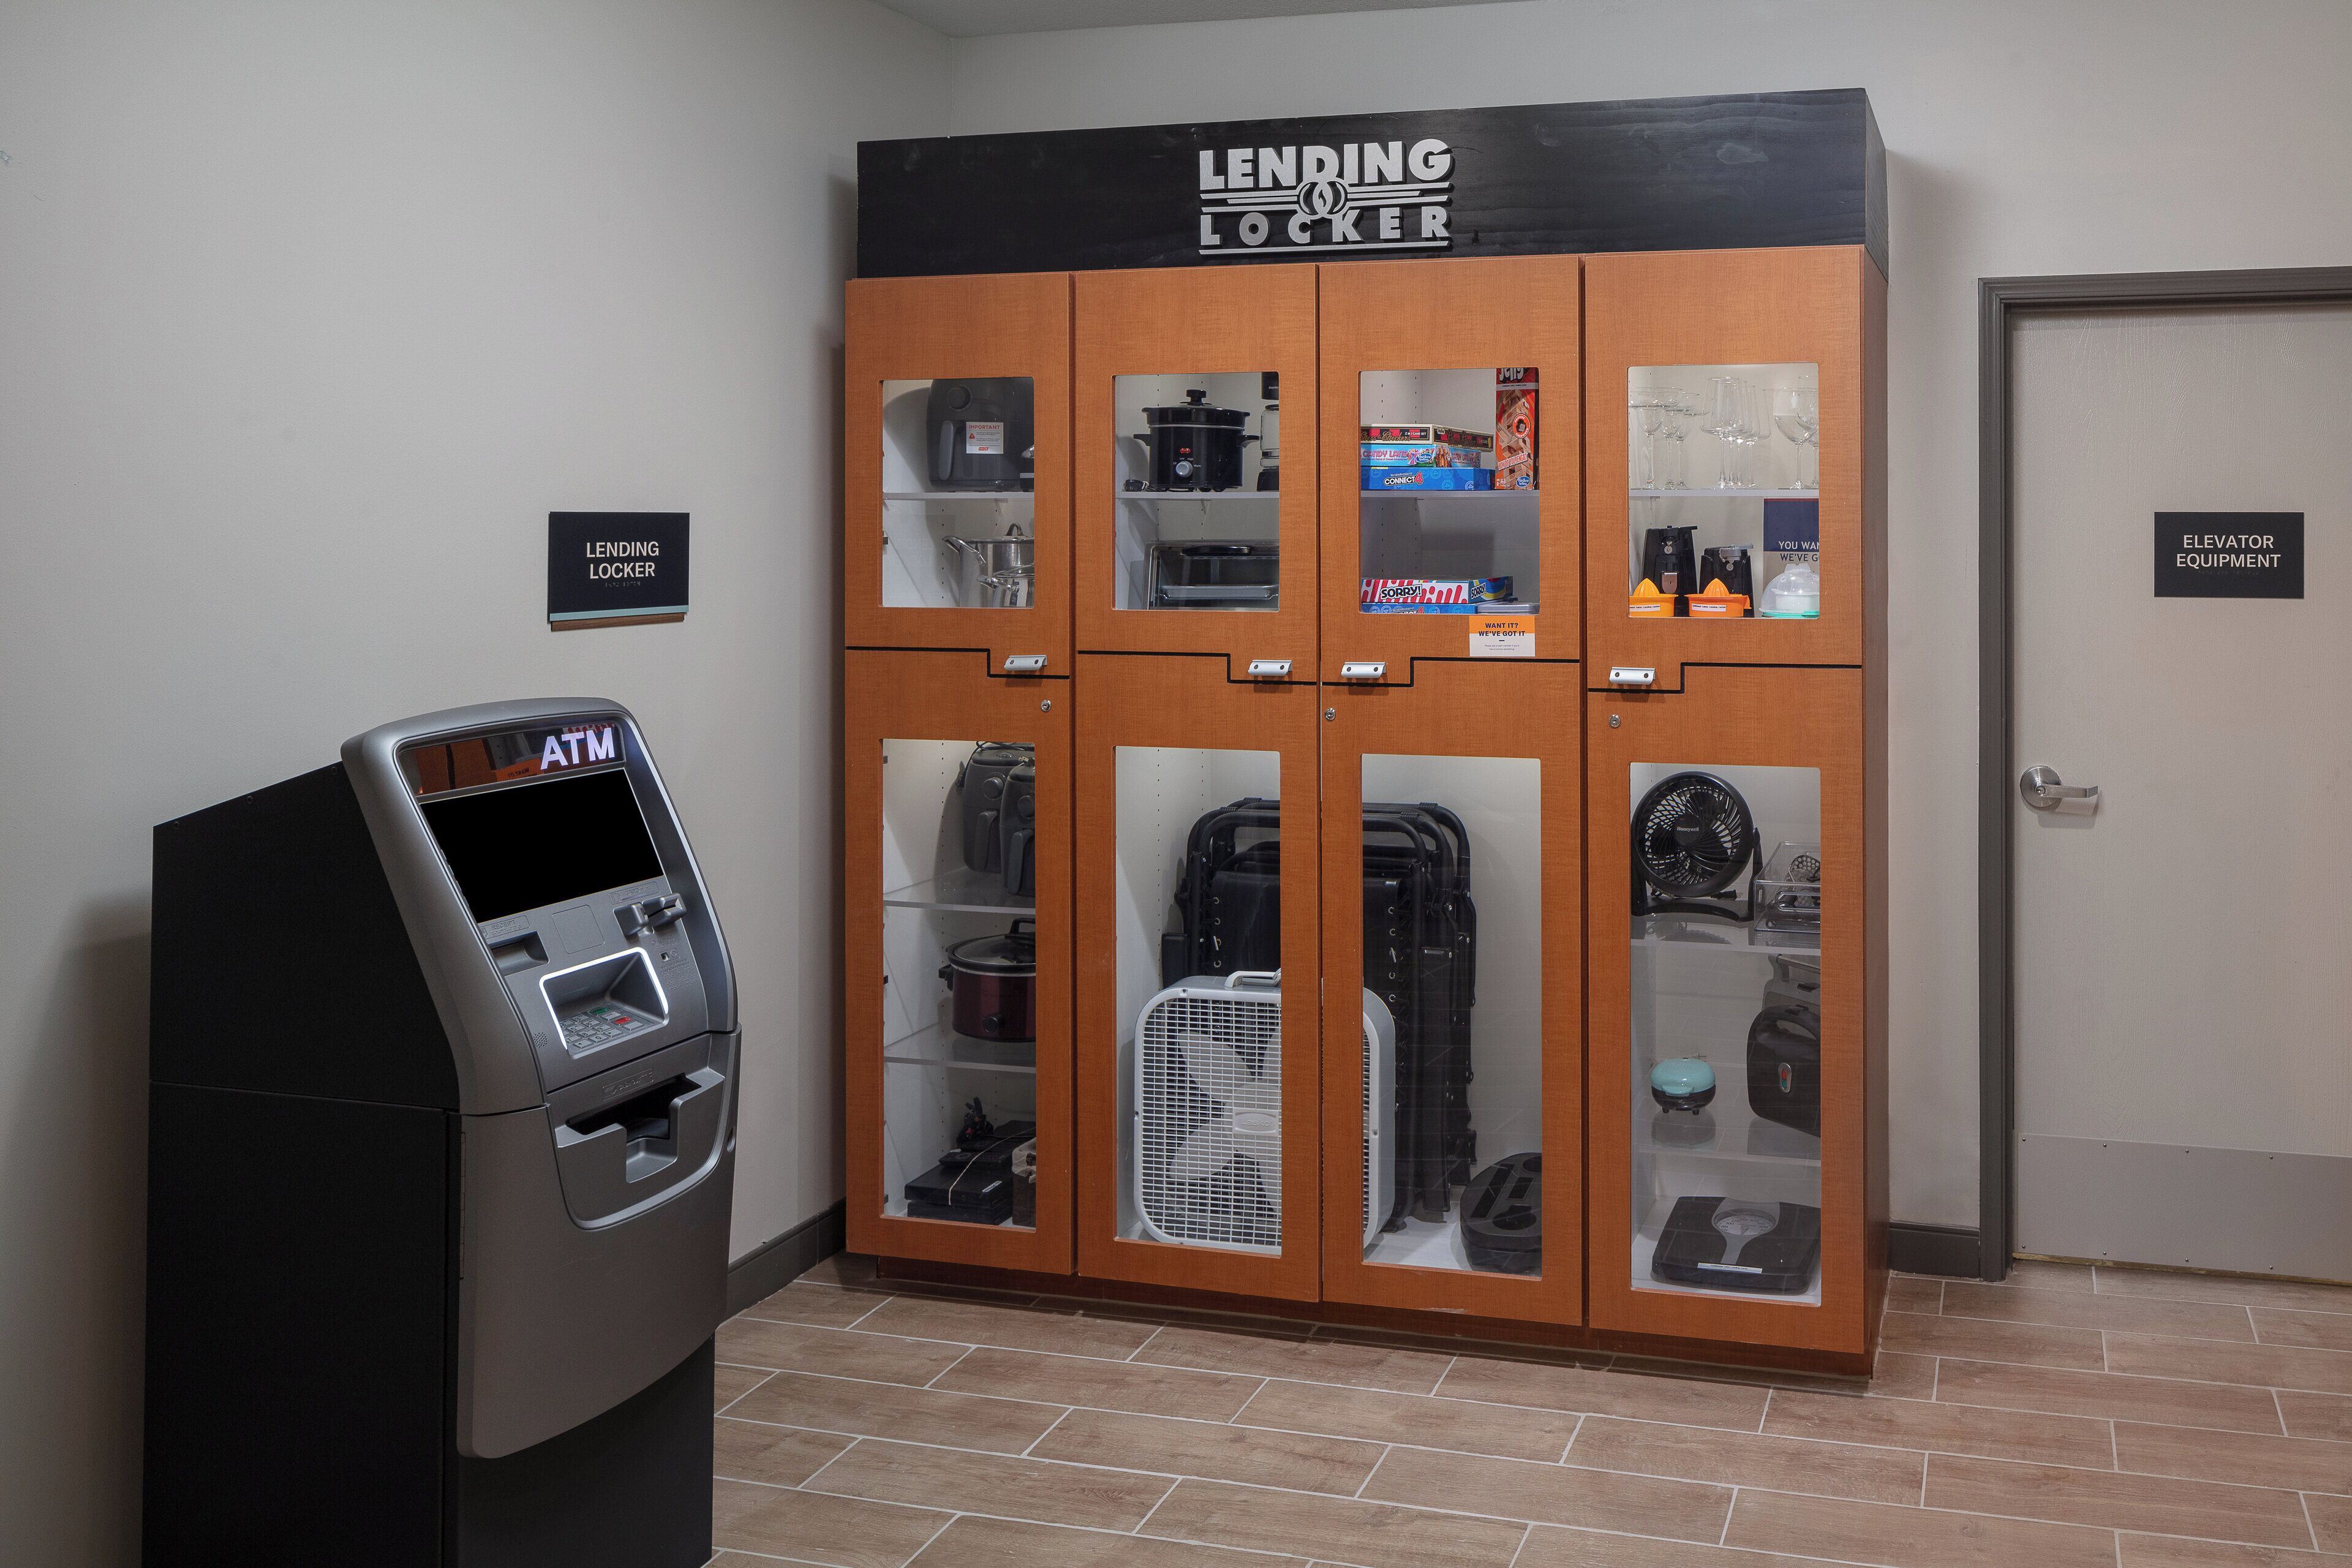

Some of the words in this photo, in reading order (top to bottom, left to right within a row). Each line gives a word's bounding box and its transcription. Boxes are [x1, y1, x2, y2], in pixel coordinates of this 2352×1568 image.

[1199, 138, 1451, 190] LENDING
[1200, 206, 1450, 246] LOCKER
[1382, 431, 1411, 442] Checkers
[1384, 476, 1415, 485] CONNECT
[1414, 472, 1423, 484] 4
[587, 541, 659, 558] LENDING
[1779, 541, 1798, 550] YOU
[2183, 535, 2274, 549] ELEVATOR
[2177, 554, 2281, 569] EQUIPMENT
[590, 562, 655, 579] LOCKER
[1381, 584, 1422, 599] SORRY!
[1471, 582, 1486, 600] SORRY!
[540, 728, 616, 770] ATM
[491, 919, 516, 930] RECEIPT
[1242, 1118, 1270, 1127] Lasko
